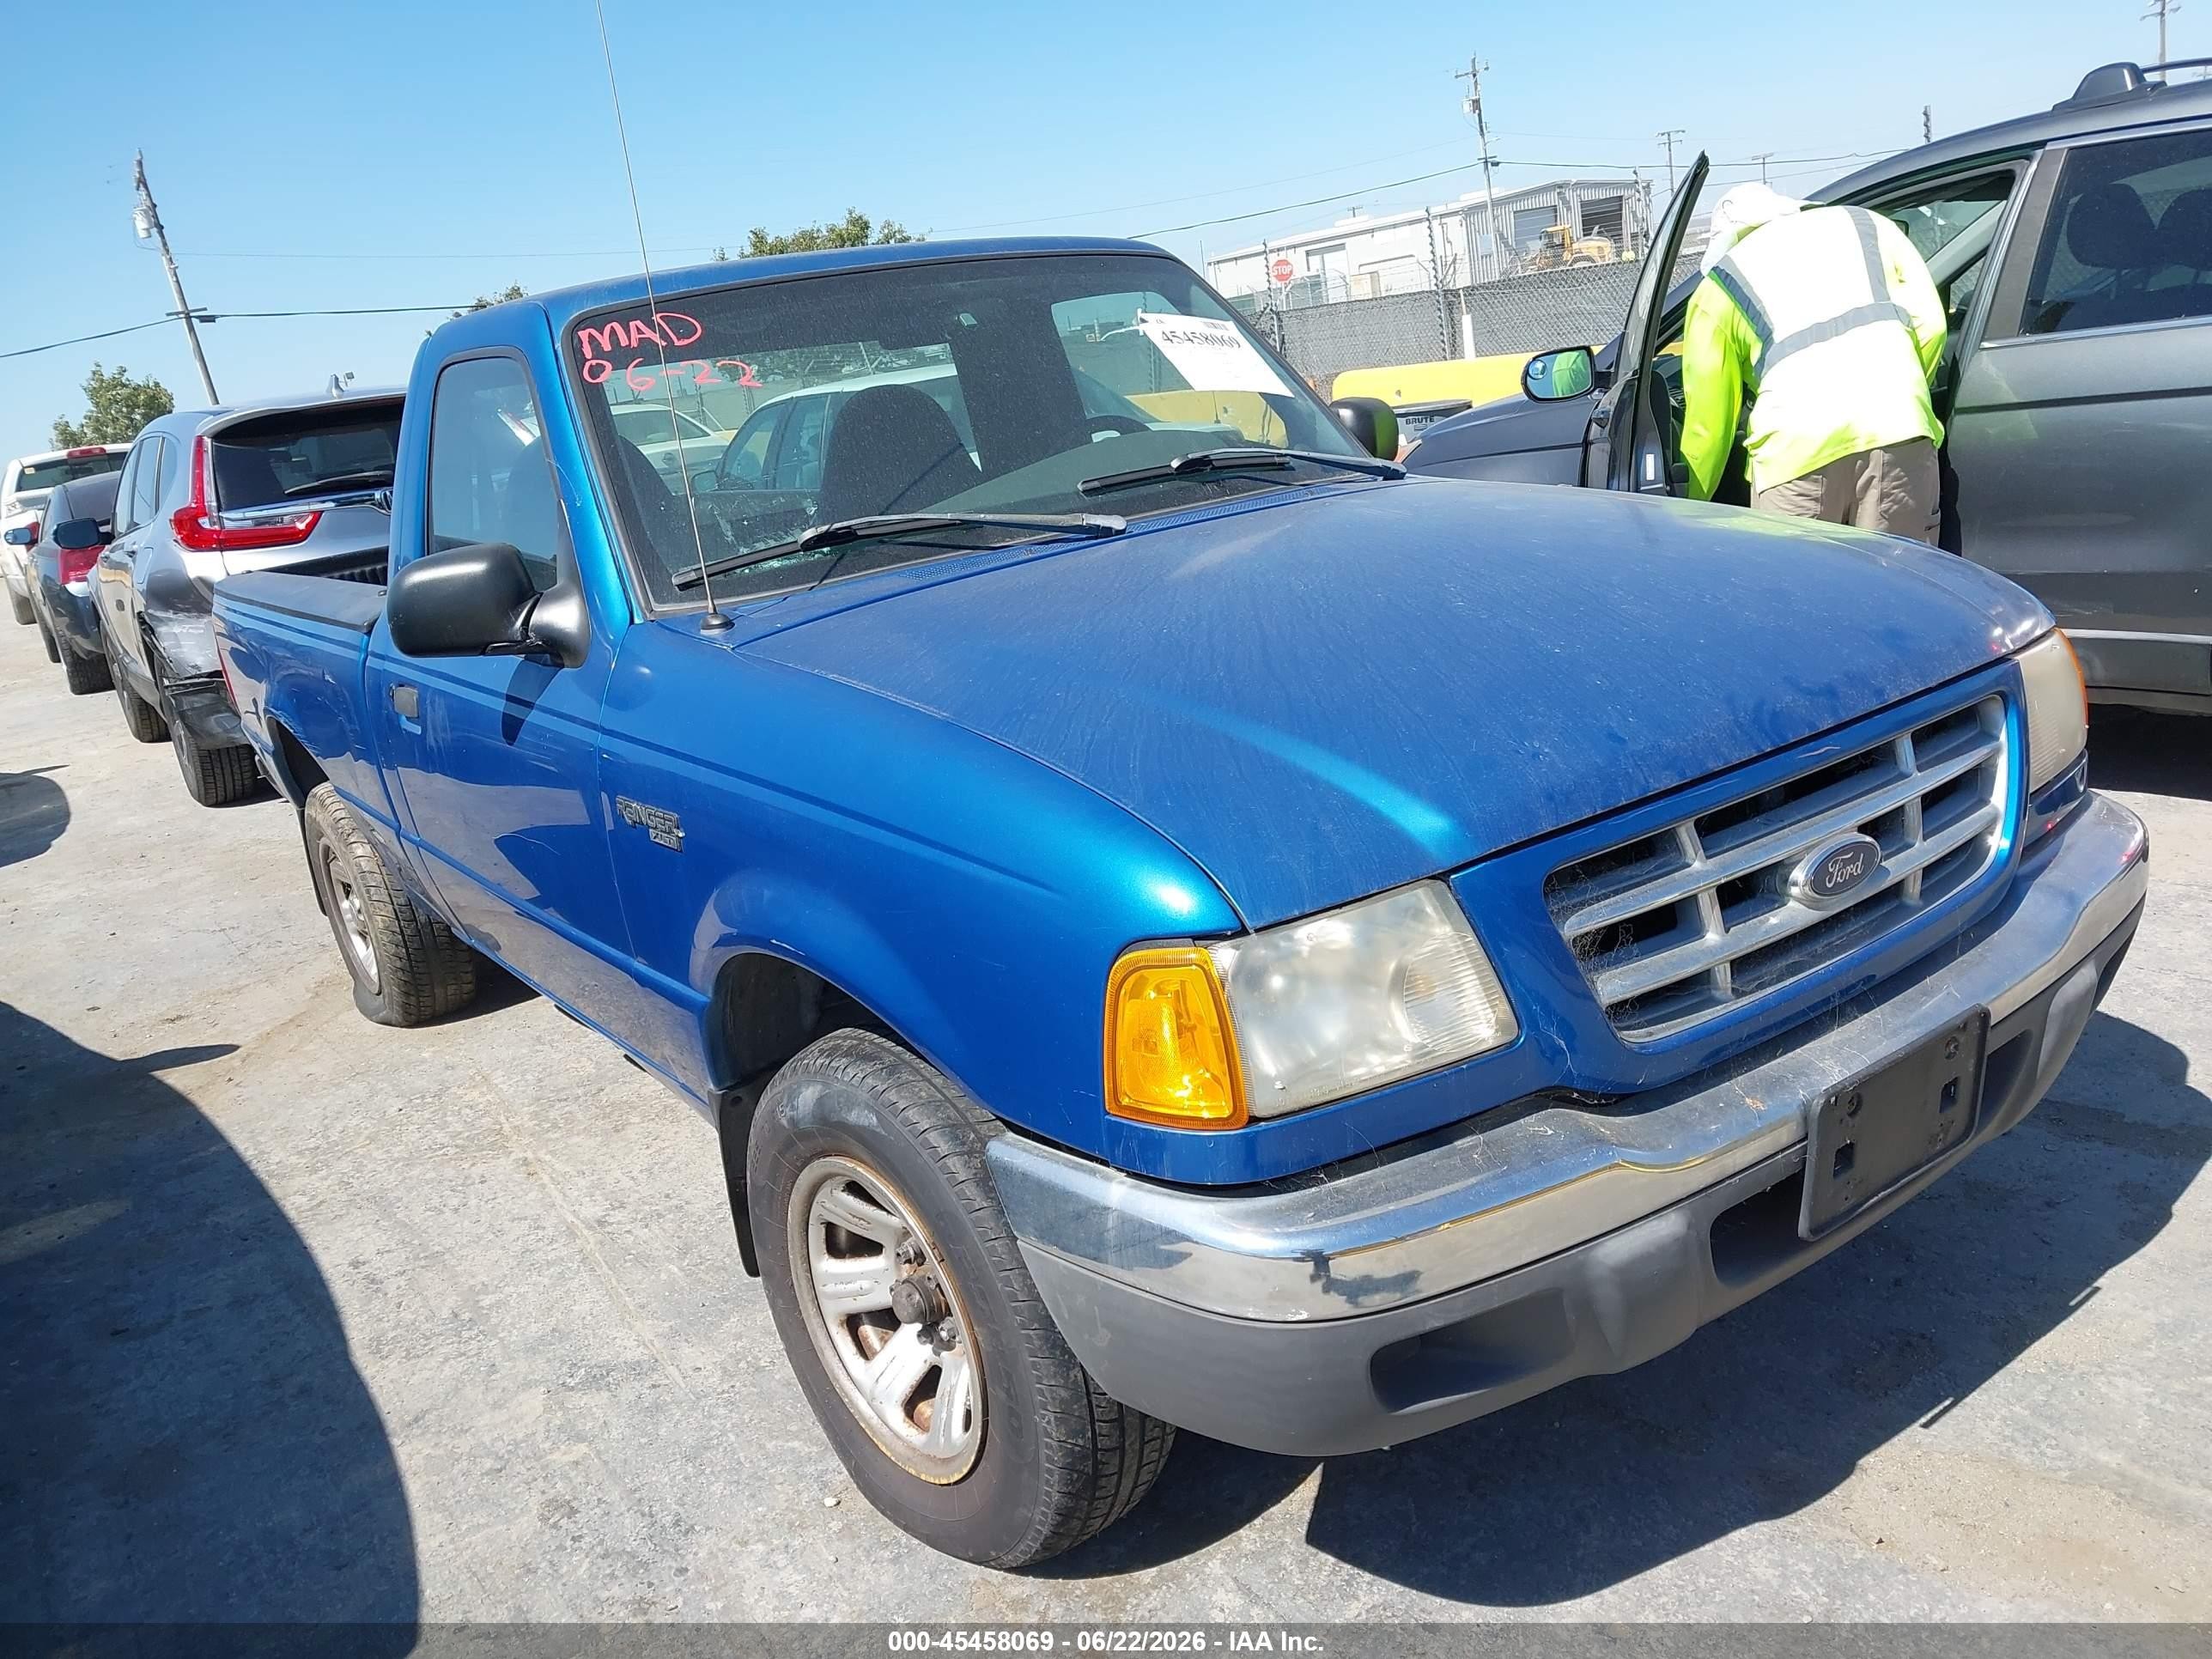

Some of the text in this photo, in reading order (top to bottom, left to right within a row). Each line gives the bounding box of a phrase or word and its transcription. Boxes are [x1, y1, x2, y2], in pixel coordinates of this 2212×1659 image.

[1273, 264, 1292, 276] STOP
[577, 312, 702, 359] MAD
[1162, 330, 1241, 349] 45458069
[1406, 416, 1435, 425] BRUTE
[616, 795, 678, 835] RANGER
[1826, 852, 1864, 888] Ford
